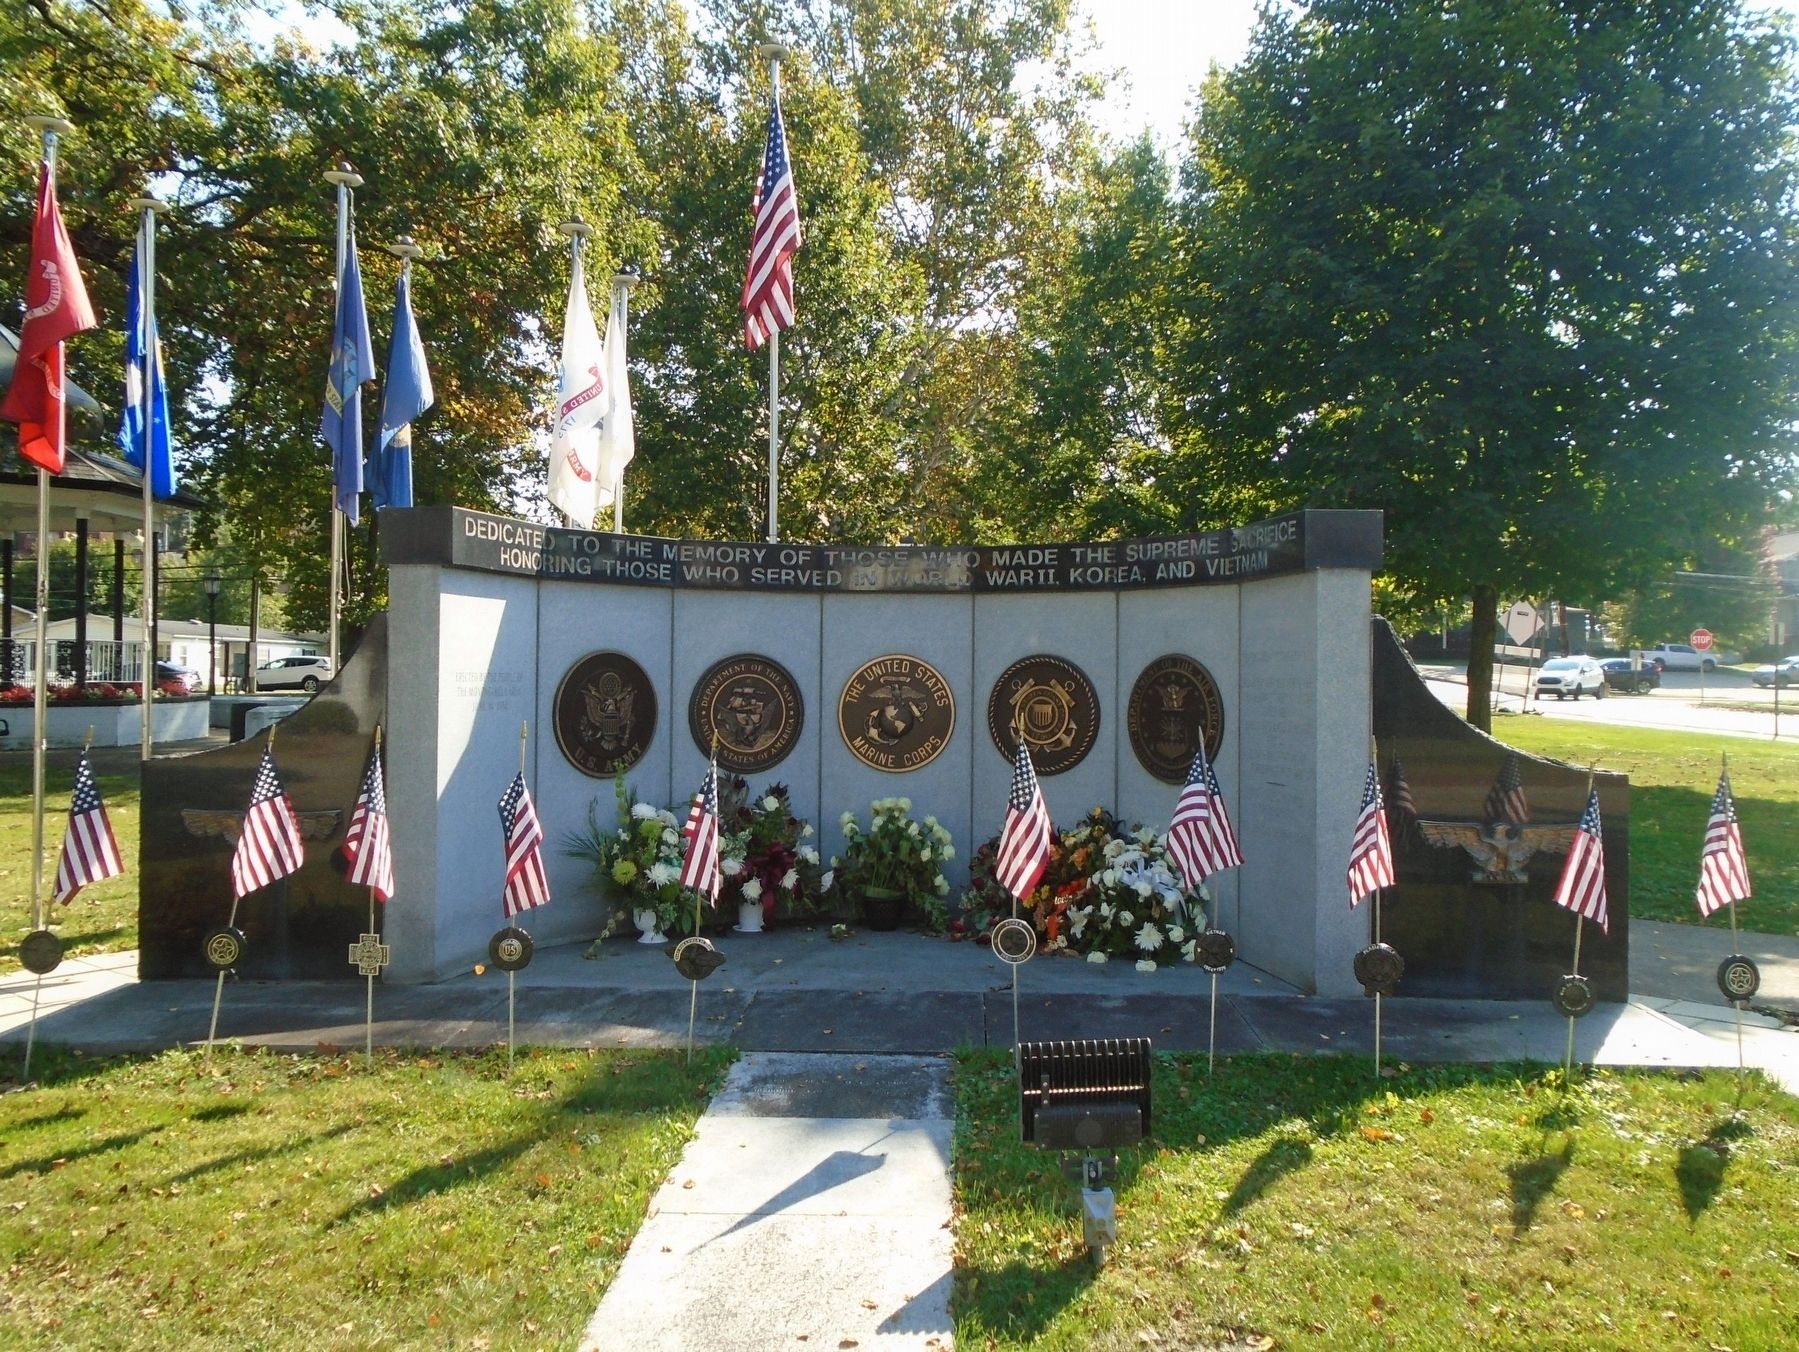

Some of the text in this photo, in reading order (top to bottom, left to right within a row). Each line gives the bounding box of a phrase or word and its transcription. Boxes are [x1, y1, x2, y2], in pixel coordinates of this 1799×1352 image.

[465, 517, 1297, 568] DEDICATED TO THE MEMORY OF THOSE WHO MADE THE SUPREME SACRIFICE
[500, 547, 591, 575] HONORING
[602, 559, 671, 581] THOSE
[683, 565, 739, 583] WHO
[751, 566, 842, 586] SERVED
[1156, 560, 1196, 580] AND
[1207, 551, 1268, 577] VIETNAM
[1692, 635, 1711, 645] STOP
[701, 663, 795, 707] DEPARTMENT OF THE NAVY
[846, 660, 949, 707] THE UNITED STATES
[770, 718, 795, 756] AMERICA
[852, 735, 941, 767] MARINE CORPS
